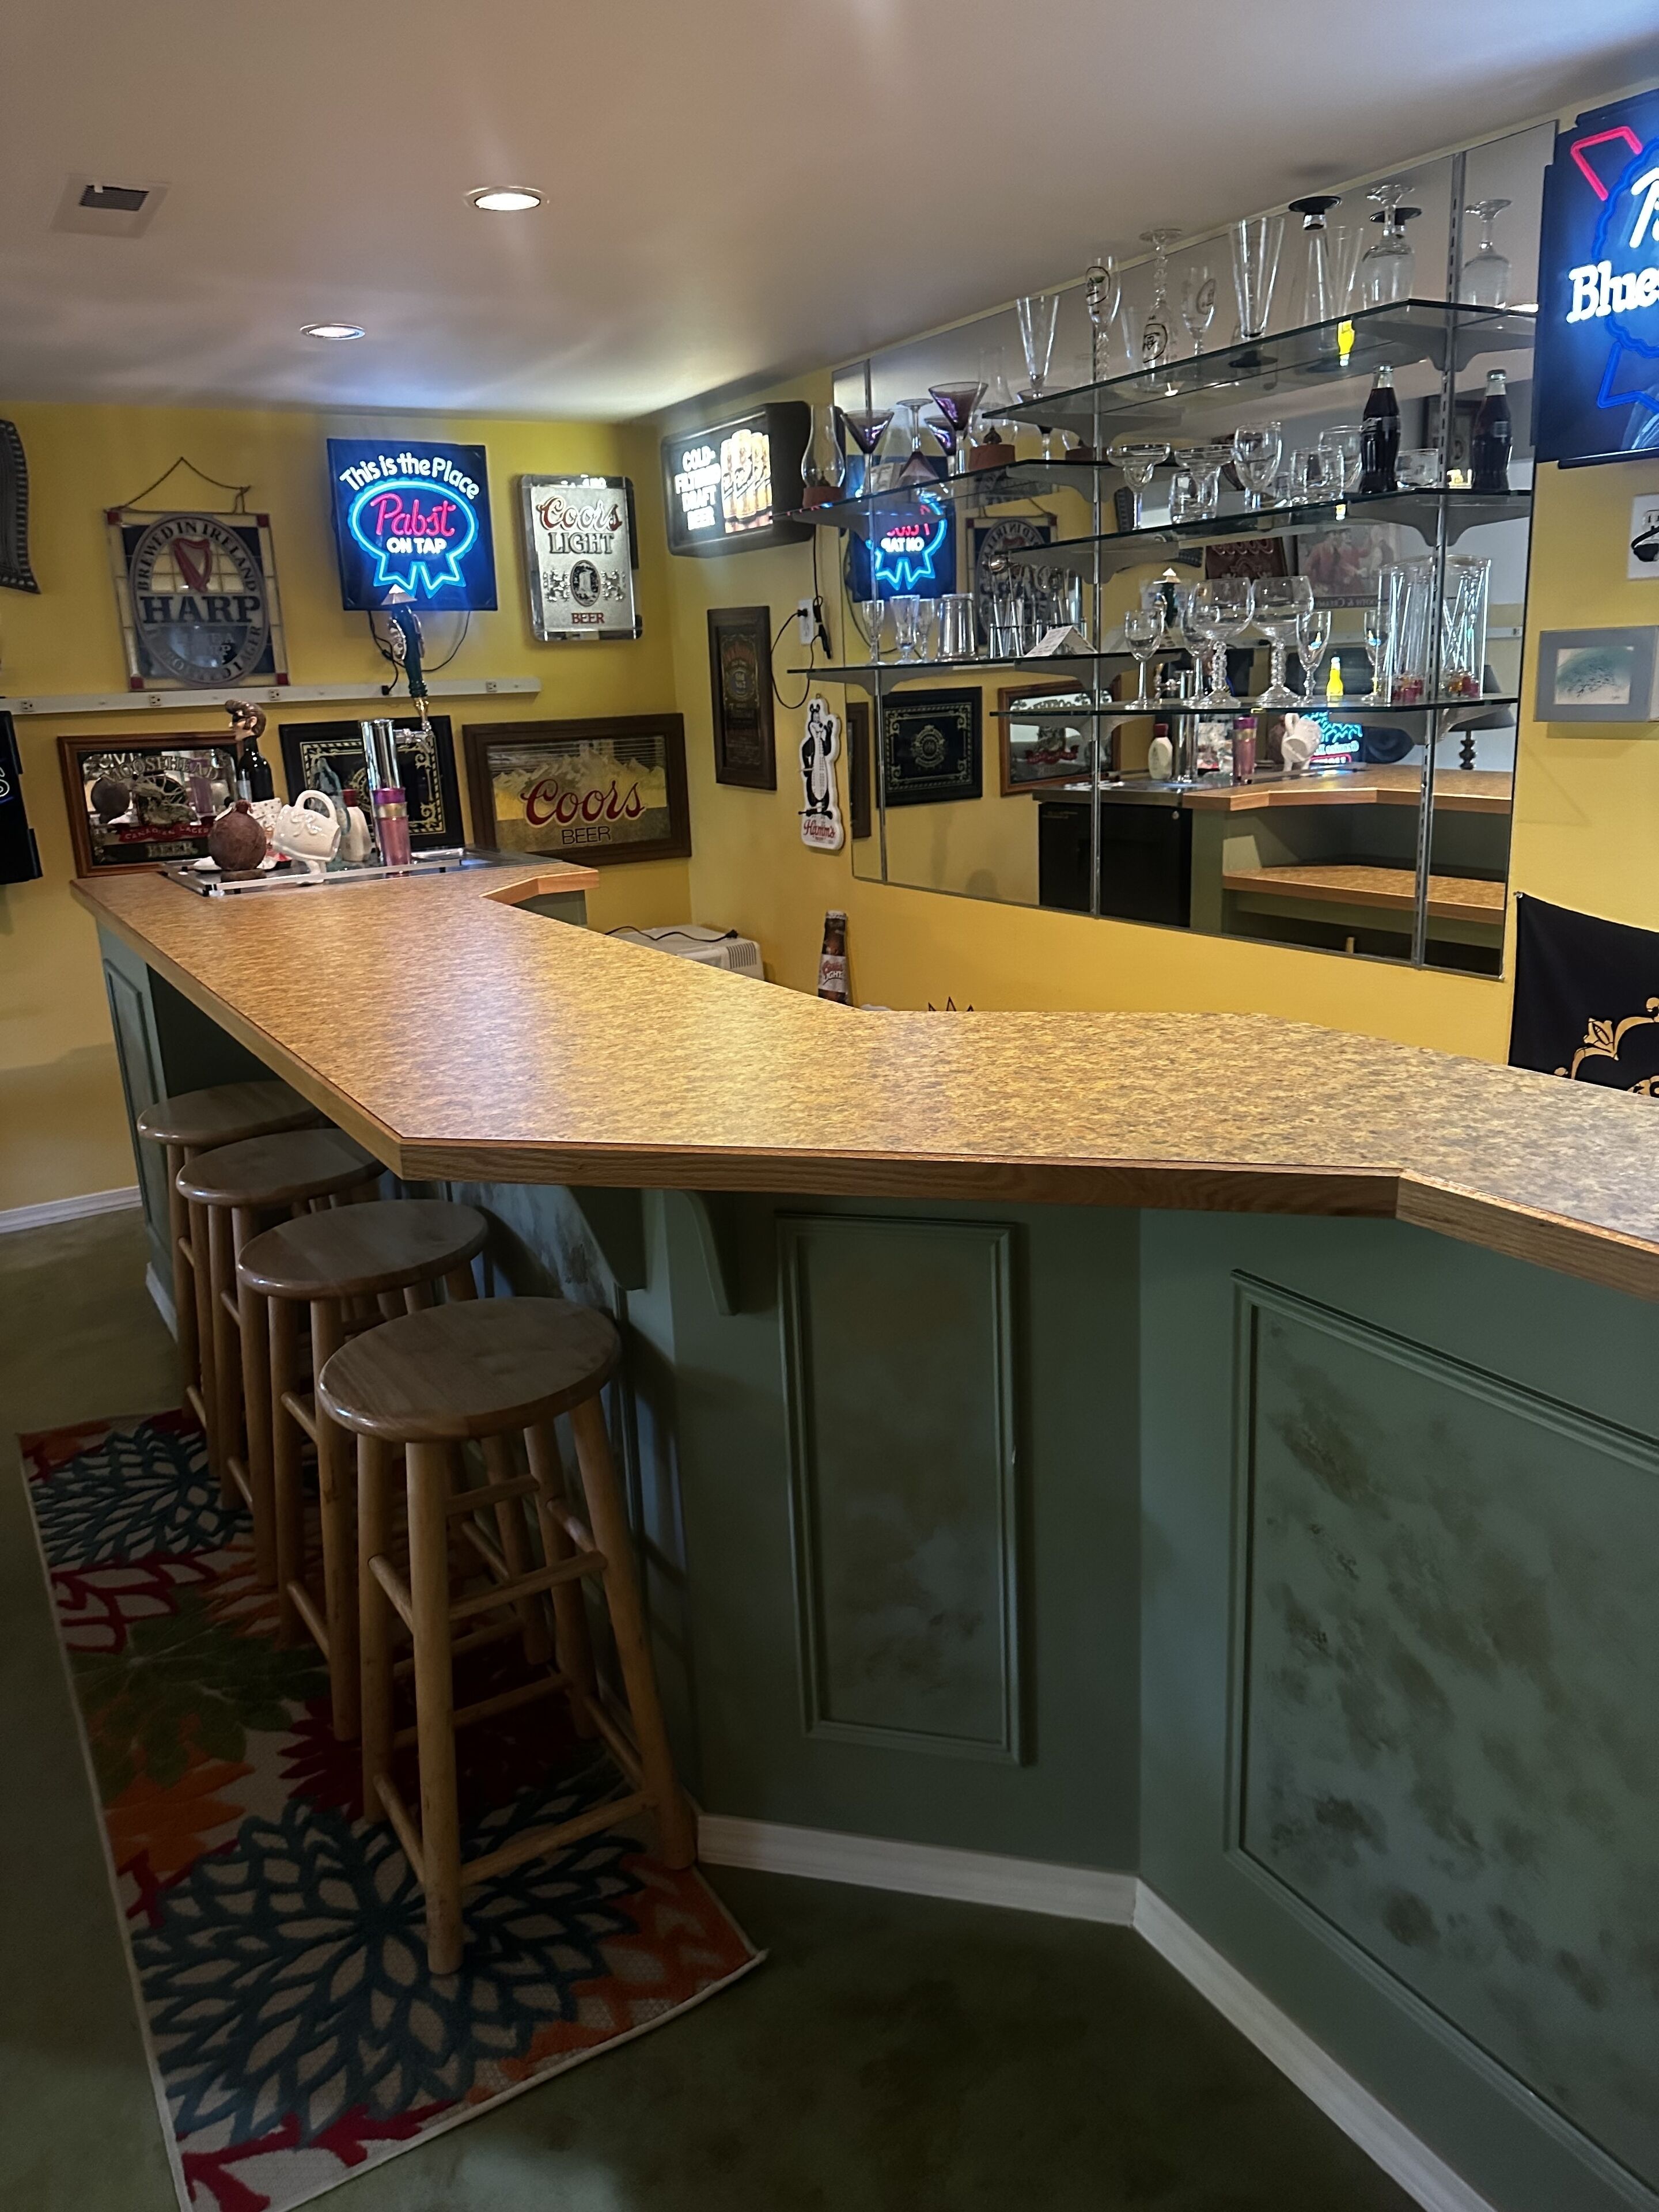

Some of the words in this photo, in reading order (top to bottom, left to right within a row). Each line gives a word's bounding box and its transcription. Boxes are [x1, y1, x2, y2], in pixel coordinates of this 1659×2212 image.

[682, 445, 716, 472] COLD-
[339, 460, 378, 492] This
[378, 454, 398, 478] is
[400, 452, 430, 477] the
[431, 456, 480, 500] Place
[682, 484, 717, 512] DRAFT
[370, 493, 456, 537] Pabst
[536, 495, 623, 532] Coors
[138, 526, 173, 591] BREWED
[176, 521, 197, 534] IN
[202, 524, 257, 592] IRELAND
[386, 537, 412, 554] ON
[412, 537, 446, 554] TAP
[548, 532, 615, 554] LIGHT
[139, 596, 261, 624] HARP
[571, 612, 605, 624] BEER
[101, 755, 219, 782] MOOSEHEAD
[521, 779, 645, 827] Coors
[124, 828, 176, 841] CANADIAN
[179, 826, 211, 835] LAGER
[562, 825, 611, 846] BEER
[803, 819, 835, 838] Hamm's
[147, 843, 196, 858] BEER
